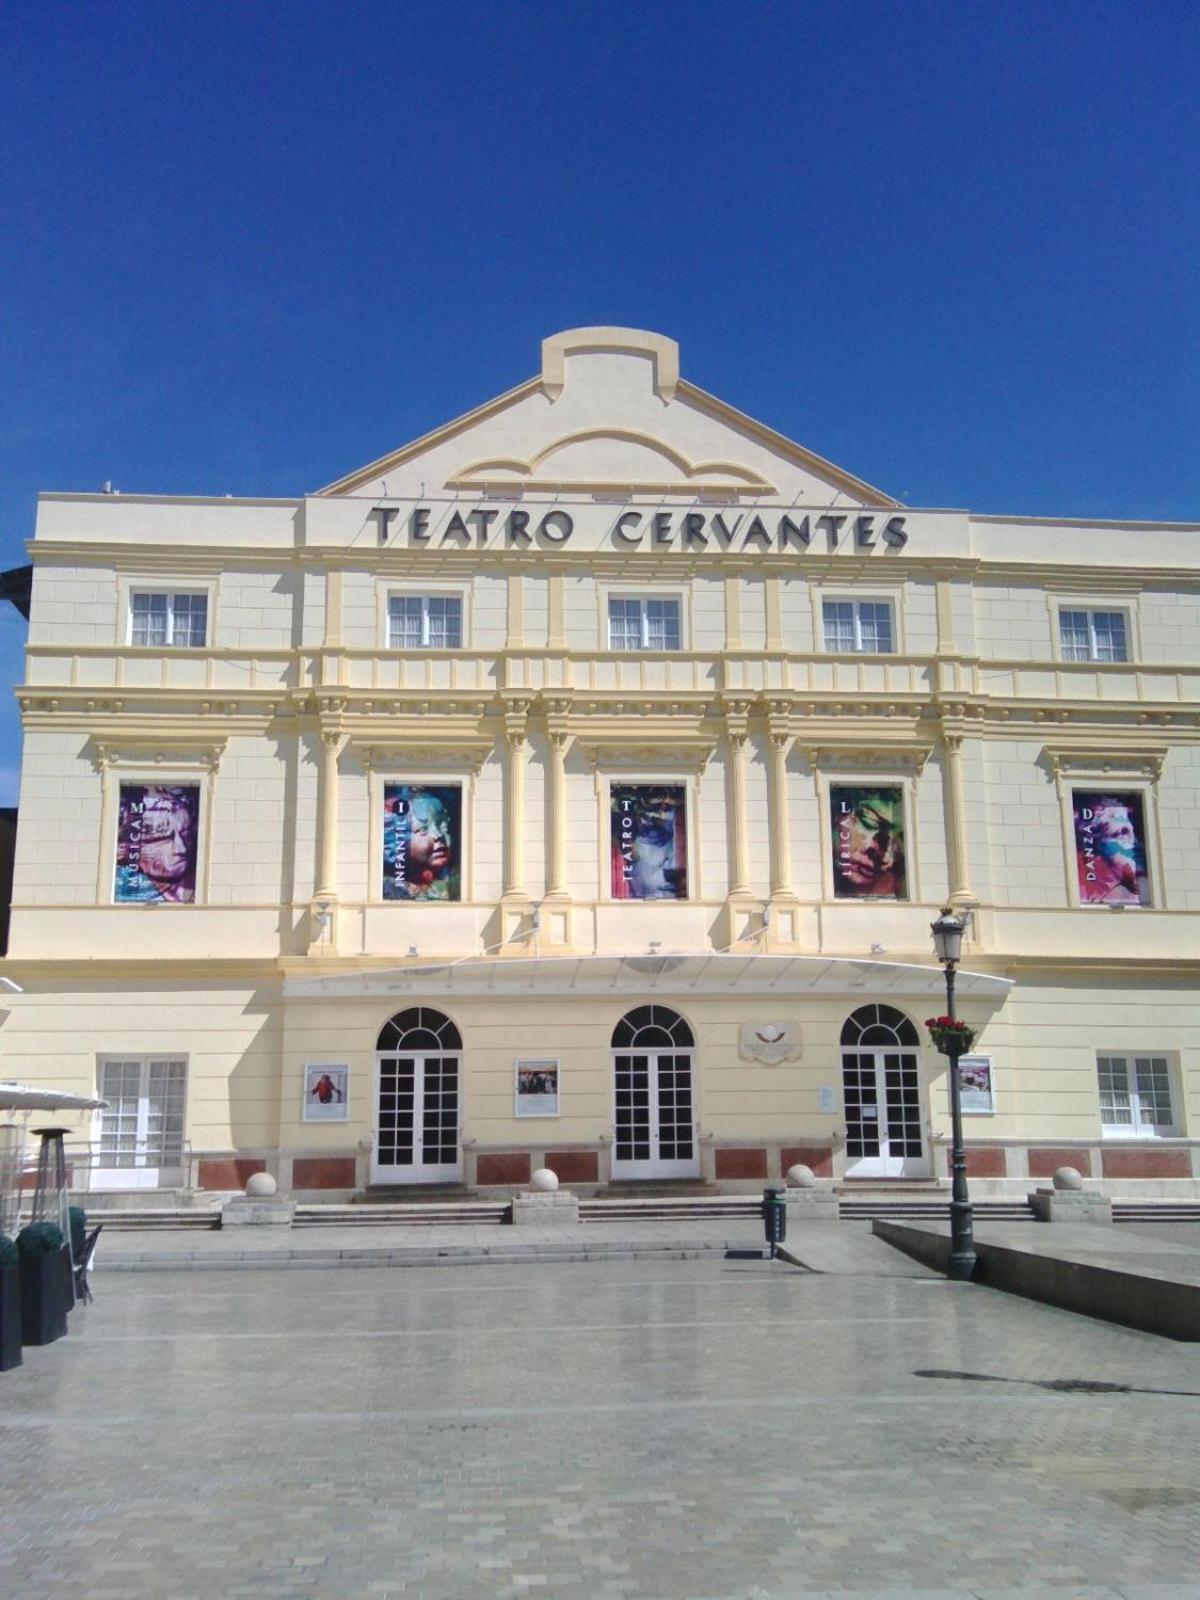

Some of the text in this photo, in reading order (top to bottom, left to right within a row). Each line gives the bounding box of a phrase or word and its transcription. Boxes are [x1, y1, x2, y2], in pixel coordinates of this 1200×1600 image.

[371, 507, 909, 549] TEATRO CERVANTES
[394, 819, 407, 887] INFANTIL
[622, 817, 633, 881] TEATRO
[1083, 825, 1097, 881] DANZA
